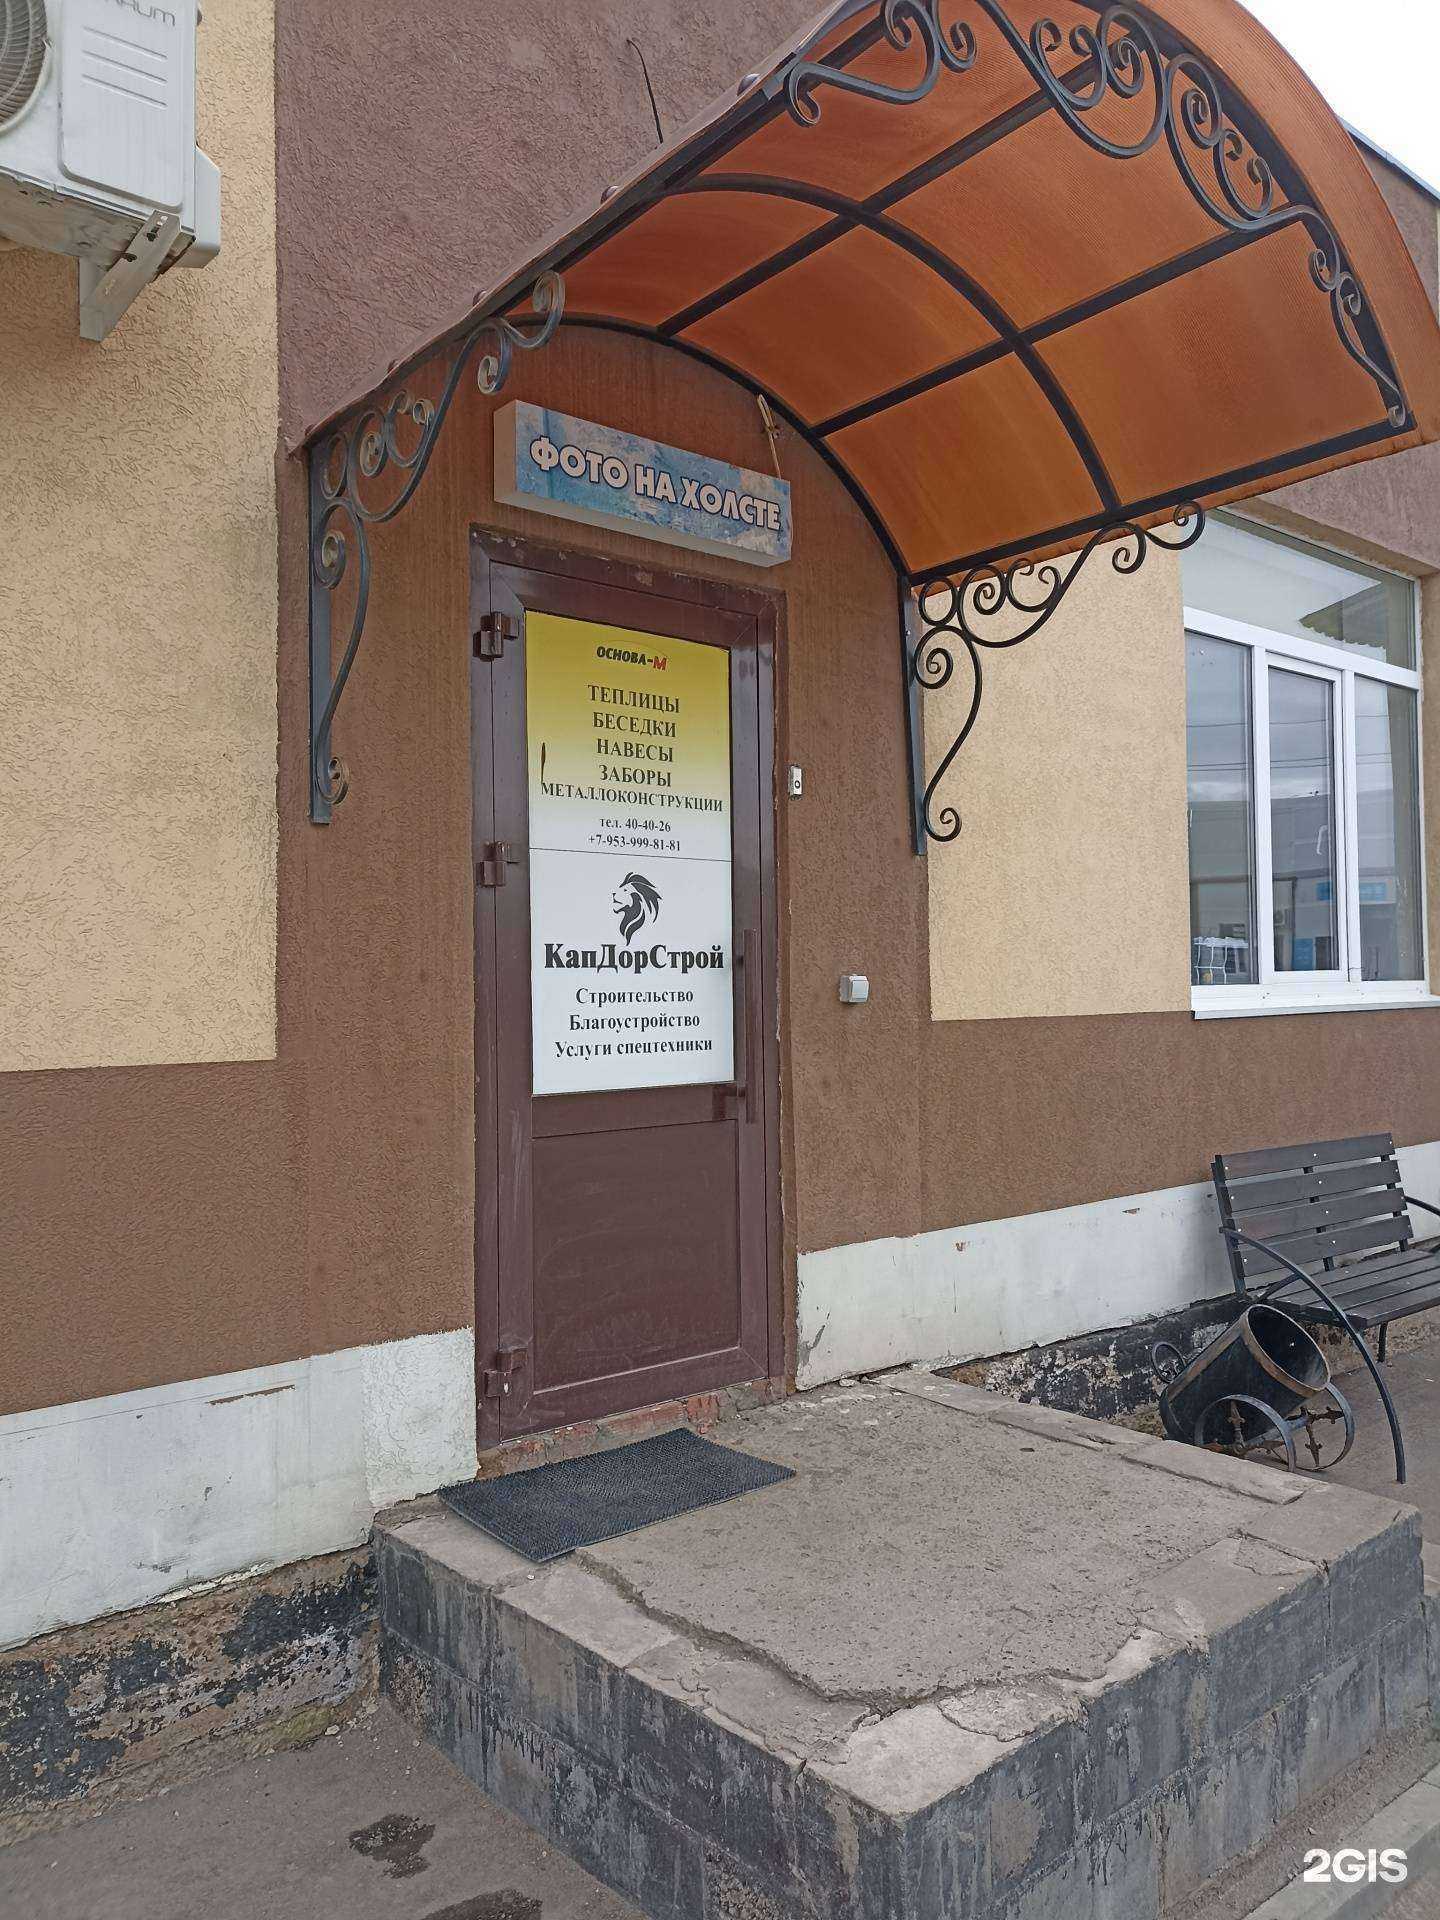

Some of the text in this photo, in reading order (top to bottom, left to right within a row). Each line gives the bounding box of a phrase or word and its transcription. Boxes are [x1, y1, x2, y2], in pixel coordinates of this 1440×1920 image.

[529, 435, 782, 531] ФОТО НА ХОЛСТЕ
[587, 684, 680, 713] ТЕПЛИЦЫ
[593, 711, 677, 738] БЕСЕДКИ
[596, 738, 674, 763] НАВЕСЫ
[598, 764, 672, 788] ЗАБОРЫ
[541, 782, 723, 812] МЕТАЛЛОКОНСТРУКЦИИ
[599, 817, 671, 833] тел. 40-40-26
[588, 834, 681, 852] +7-953-999-81-81
[544, 943, 724, 974] КапДорСтрой
[575, 987, 694, 1008] Строительство
[569, 1012, 701, 1033] Благоустройство
[555, 1039, 713, 1061] Услуги спецтехники
